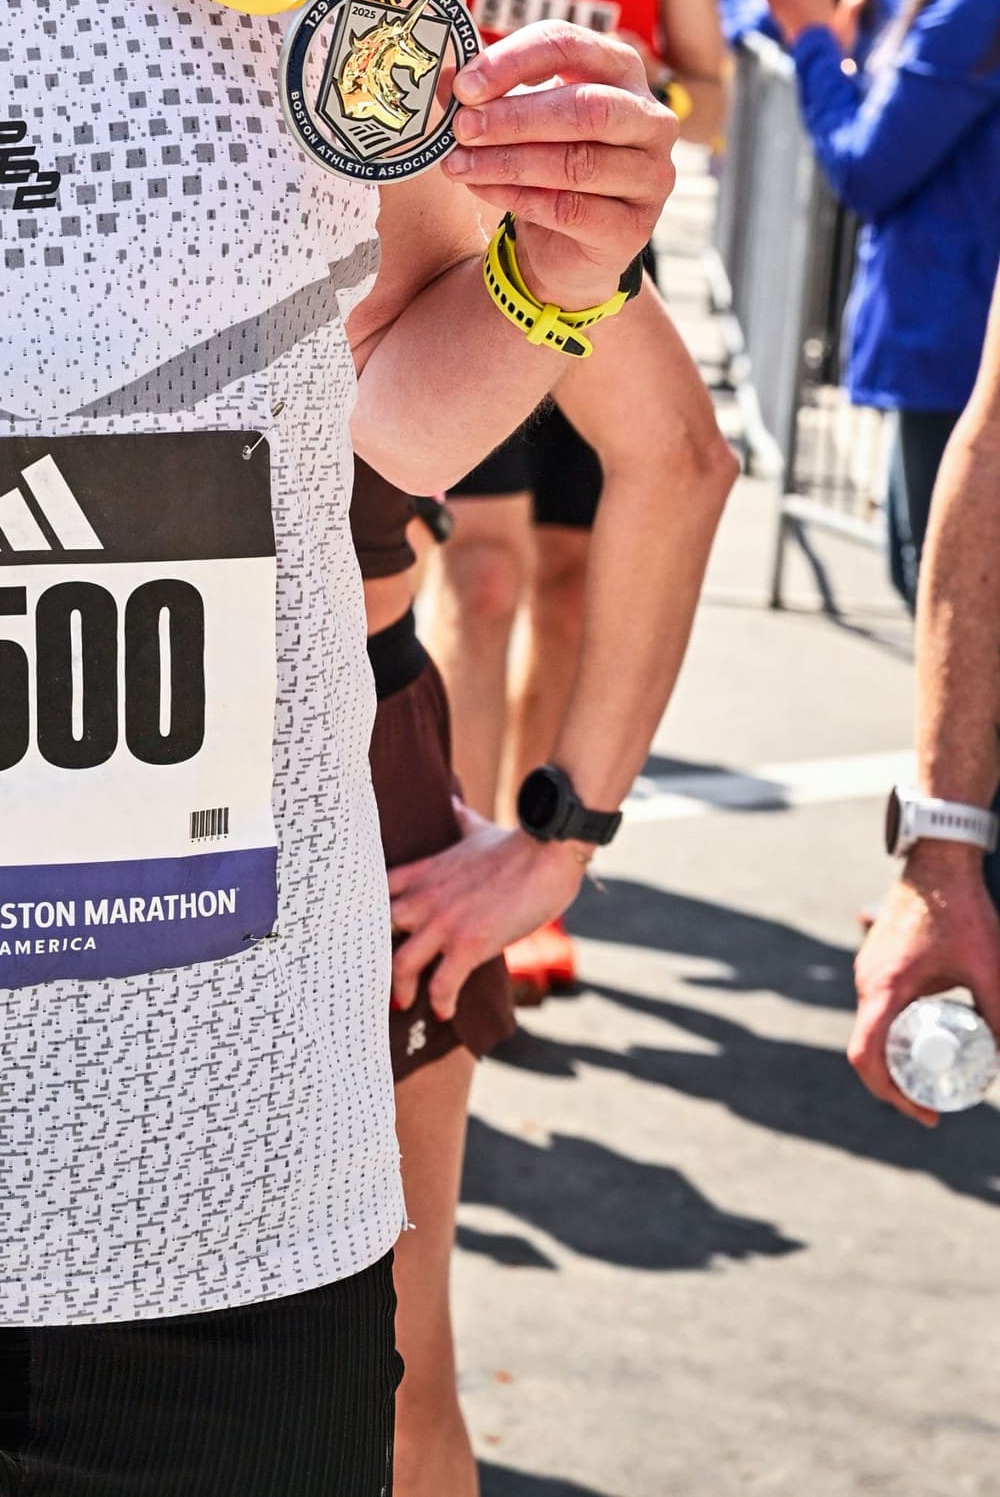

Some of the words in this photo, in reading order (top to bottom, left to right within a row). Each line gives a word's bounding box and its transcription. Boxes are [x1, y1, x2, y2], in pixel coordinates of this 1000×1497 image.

[351, 6, 377, 20] 2025
[291, 91, 319, 144] BOSTON
[317, 145, 374, 176] ATHLETIC
[84, 888, 239, 926] MARATHON
